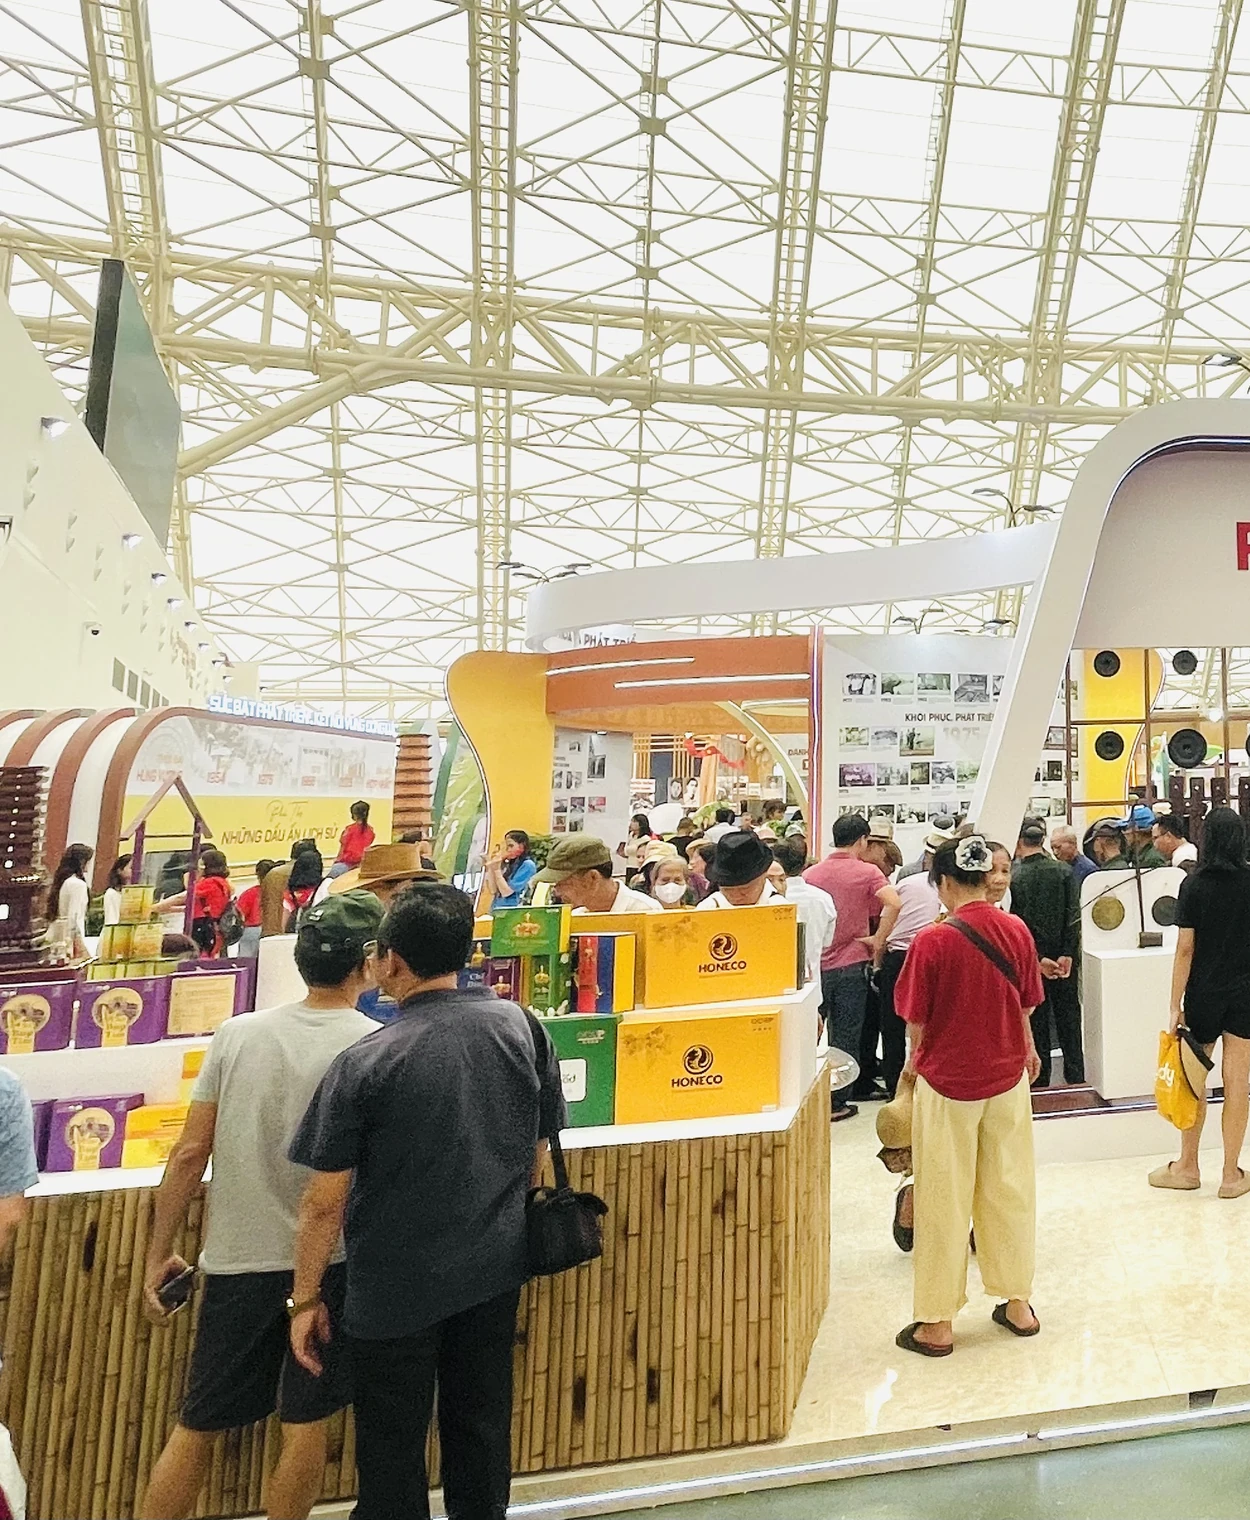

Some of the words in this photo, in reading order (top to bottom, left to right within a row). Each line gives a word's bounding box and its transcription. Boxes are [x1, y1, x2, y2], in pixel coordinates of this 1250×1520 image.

[220, 826, 262, 845] NHỮNG
[265, 823, 285, 844] DẤU
[698, 961, 747, 973] HONECO
[671, 1075, 723, 1088] HONECO
